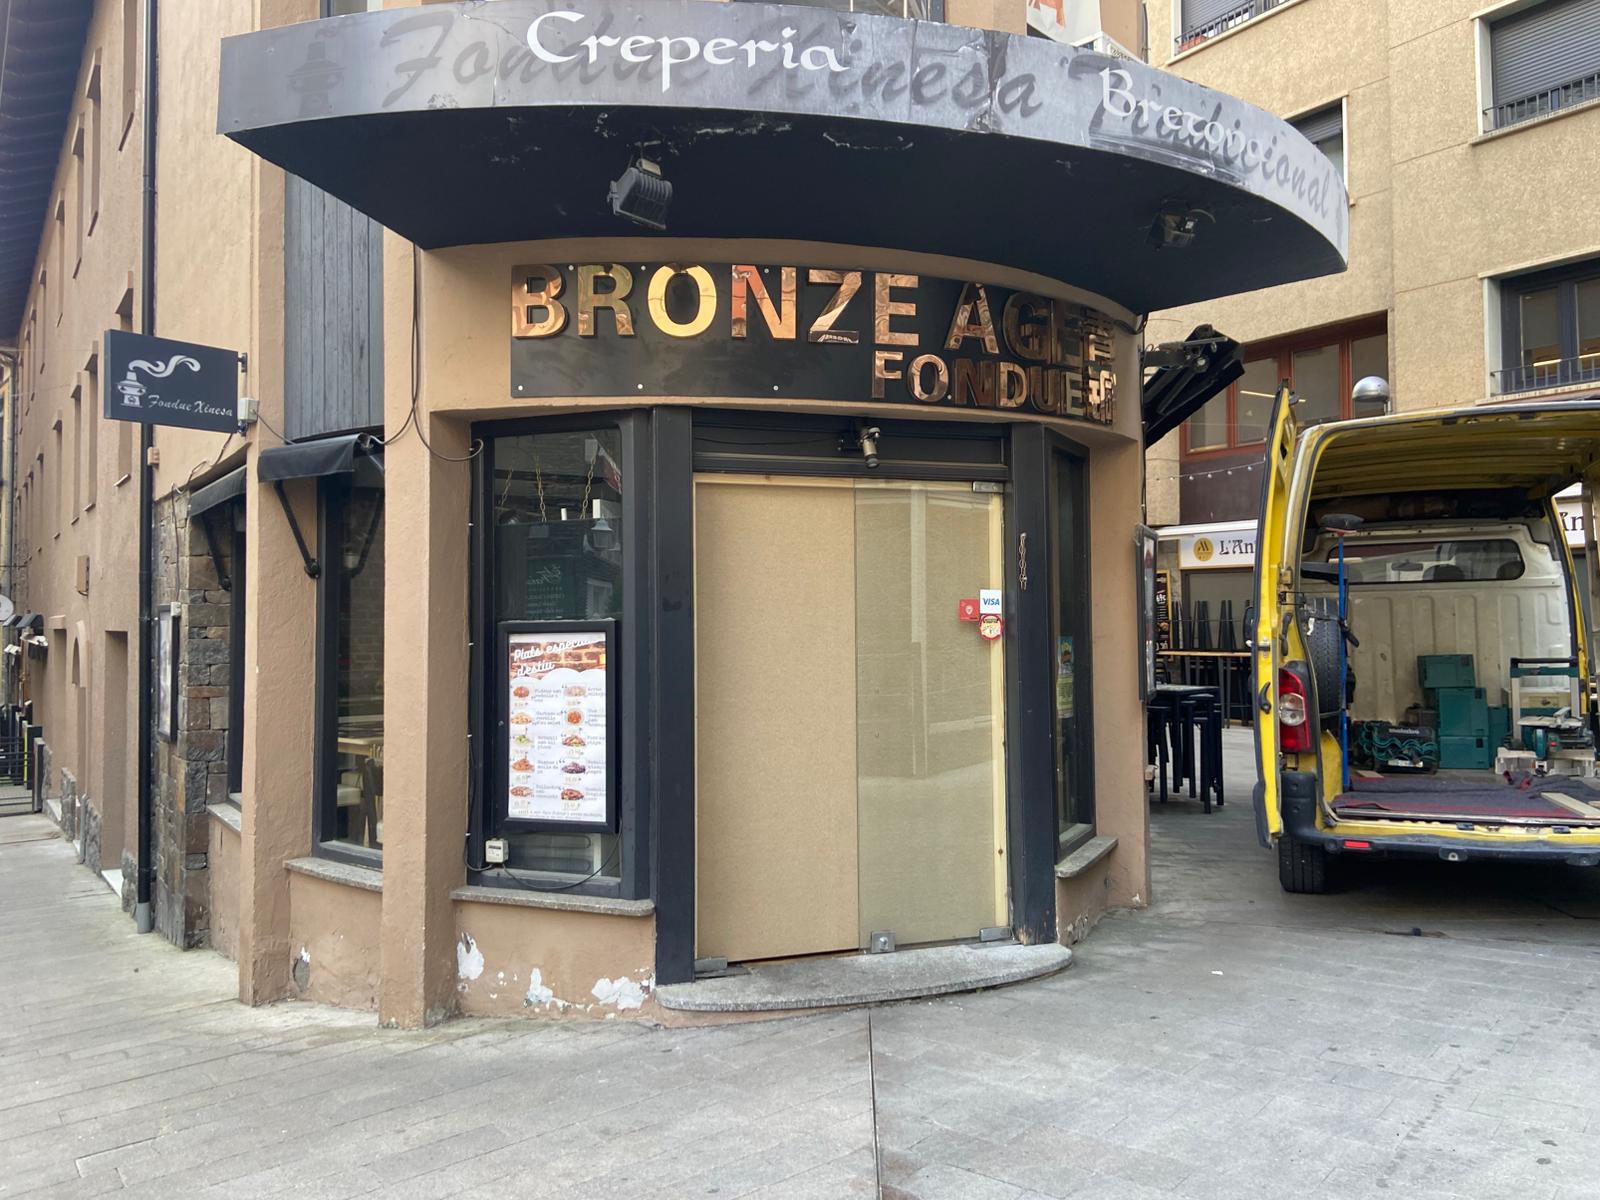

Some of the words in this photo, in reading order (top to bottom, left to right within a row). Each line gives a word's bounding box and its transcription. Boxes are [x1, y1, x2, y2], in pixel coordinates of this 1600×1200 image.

[526, 10, 851, 94] Creperia
[511, 263, 920, 347] BRONZE
[943, 281, 1085, 368] AGE
[194, 401, 233, 417] Xinesa
[871, 350, 1085, 417] FONDUE
[982, 597, 1001, 606] VISA
